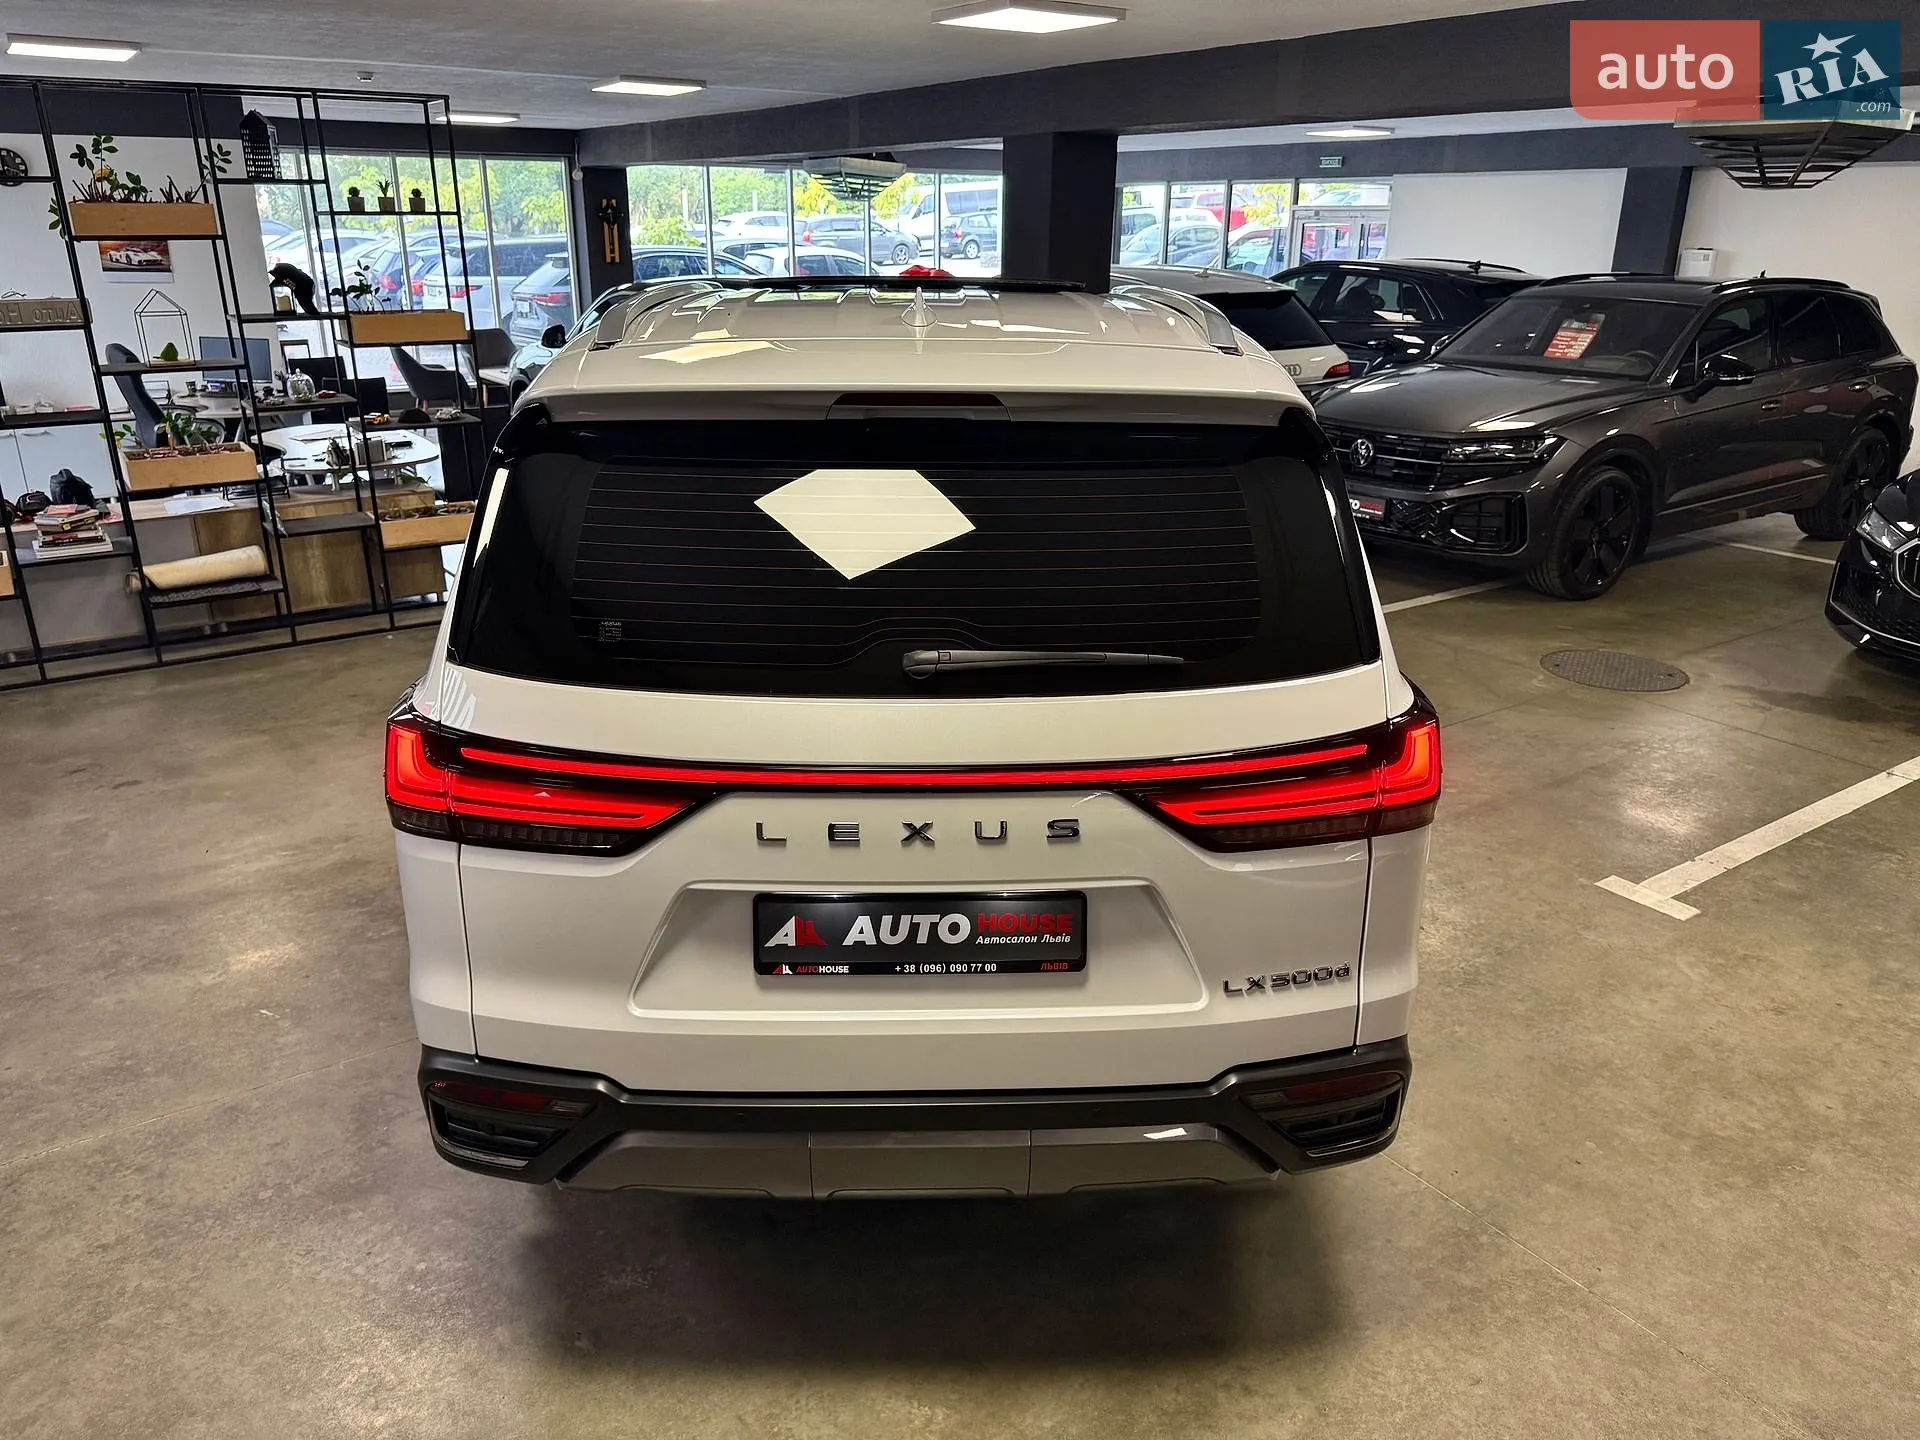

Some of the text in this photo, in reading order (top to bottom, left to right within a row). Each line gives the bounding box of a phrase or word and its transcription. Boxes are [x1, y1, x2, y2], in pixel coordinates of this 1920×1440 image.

[755, 818, 1081, 843] LEXUS
[842, 914, 971, 945] AUTO
[977, 913, 1073, 933] HOUSE
[975, 933, 1071, 945] Автосалон Львів
[903, 964, 916, 973] 38
[919, 962, 946, 974] (096)
[950, 964, 968, 973] 090
[970, 964, 983, 973] 77
[984, 963, 997, 973] 00
